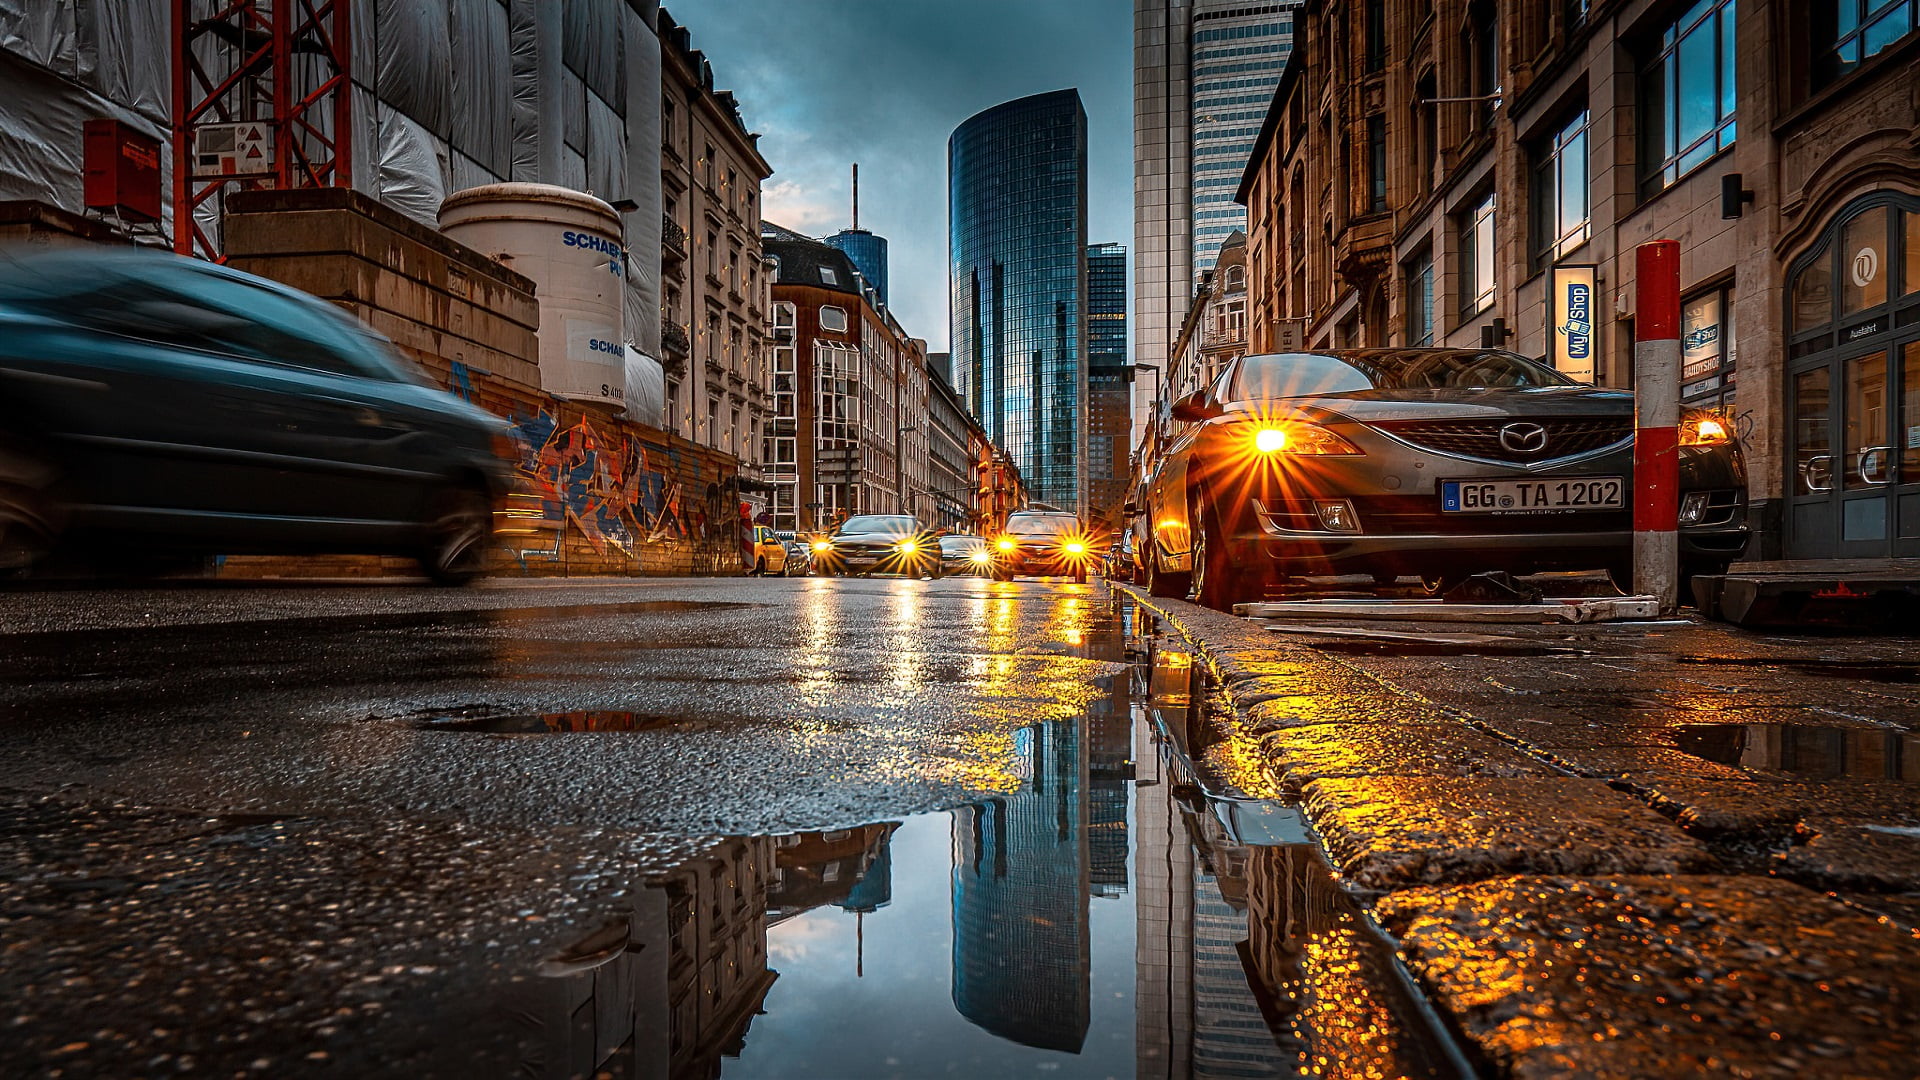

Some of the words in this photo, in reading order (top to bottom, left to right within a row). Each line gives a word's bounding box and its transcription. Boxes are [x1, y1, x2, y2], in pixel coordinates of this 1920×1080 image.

[1569, 287, 1589, 319] Shop
[1569, 332, 1589, 355] My
[601, 383, 609, 396] S
[1463, 485, 1496, 507] GG
[1516, 483, 1549, 507] TA
[1555, 481, 1619, 506] 1202
